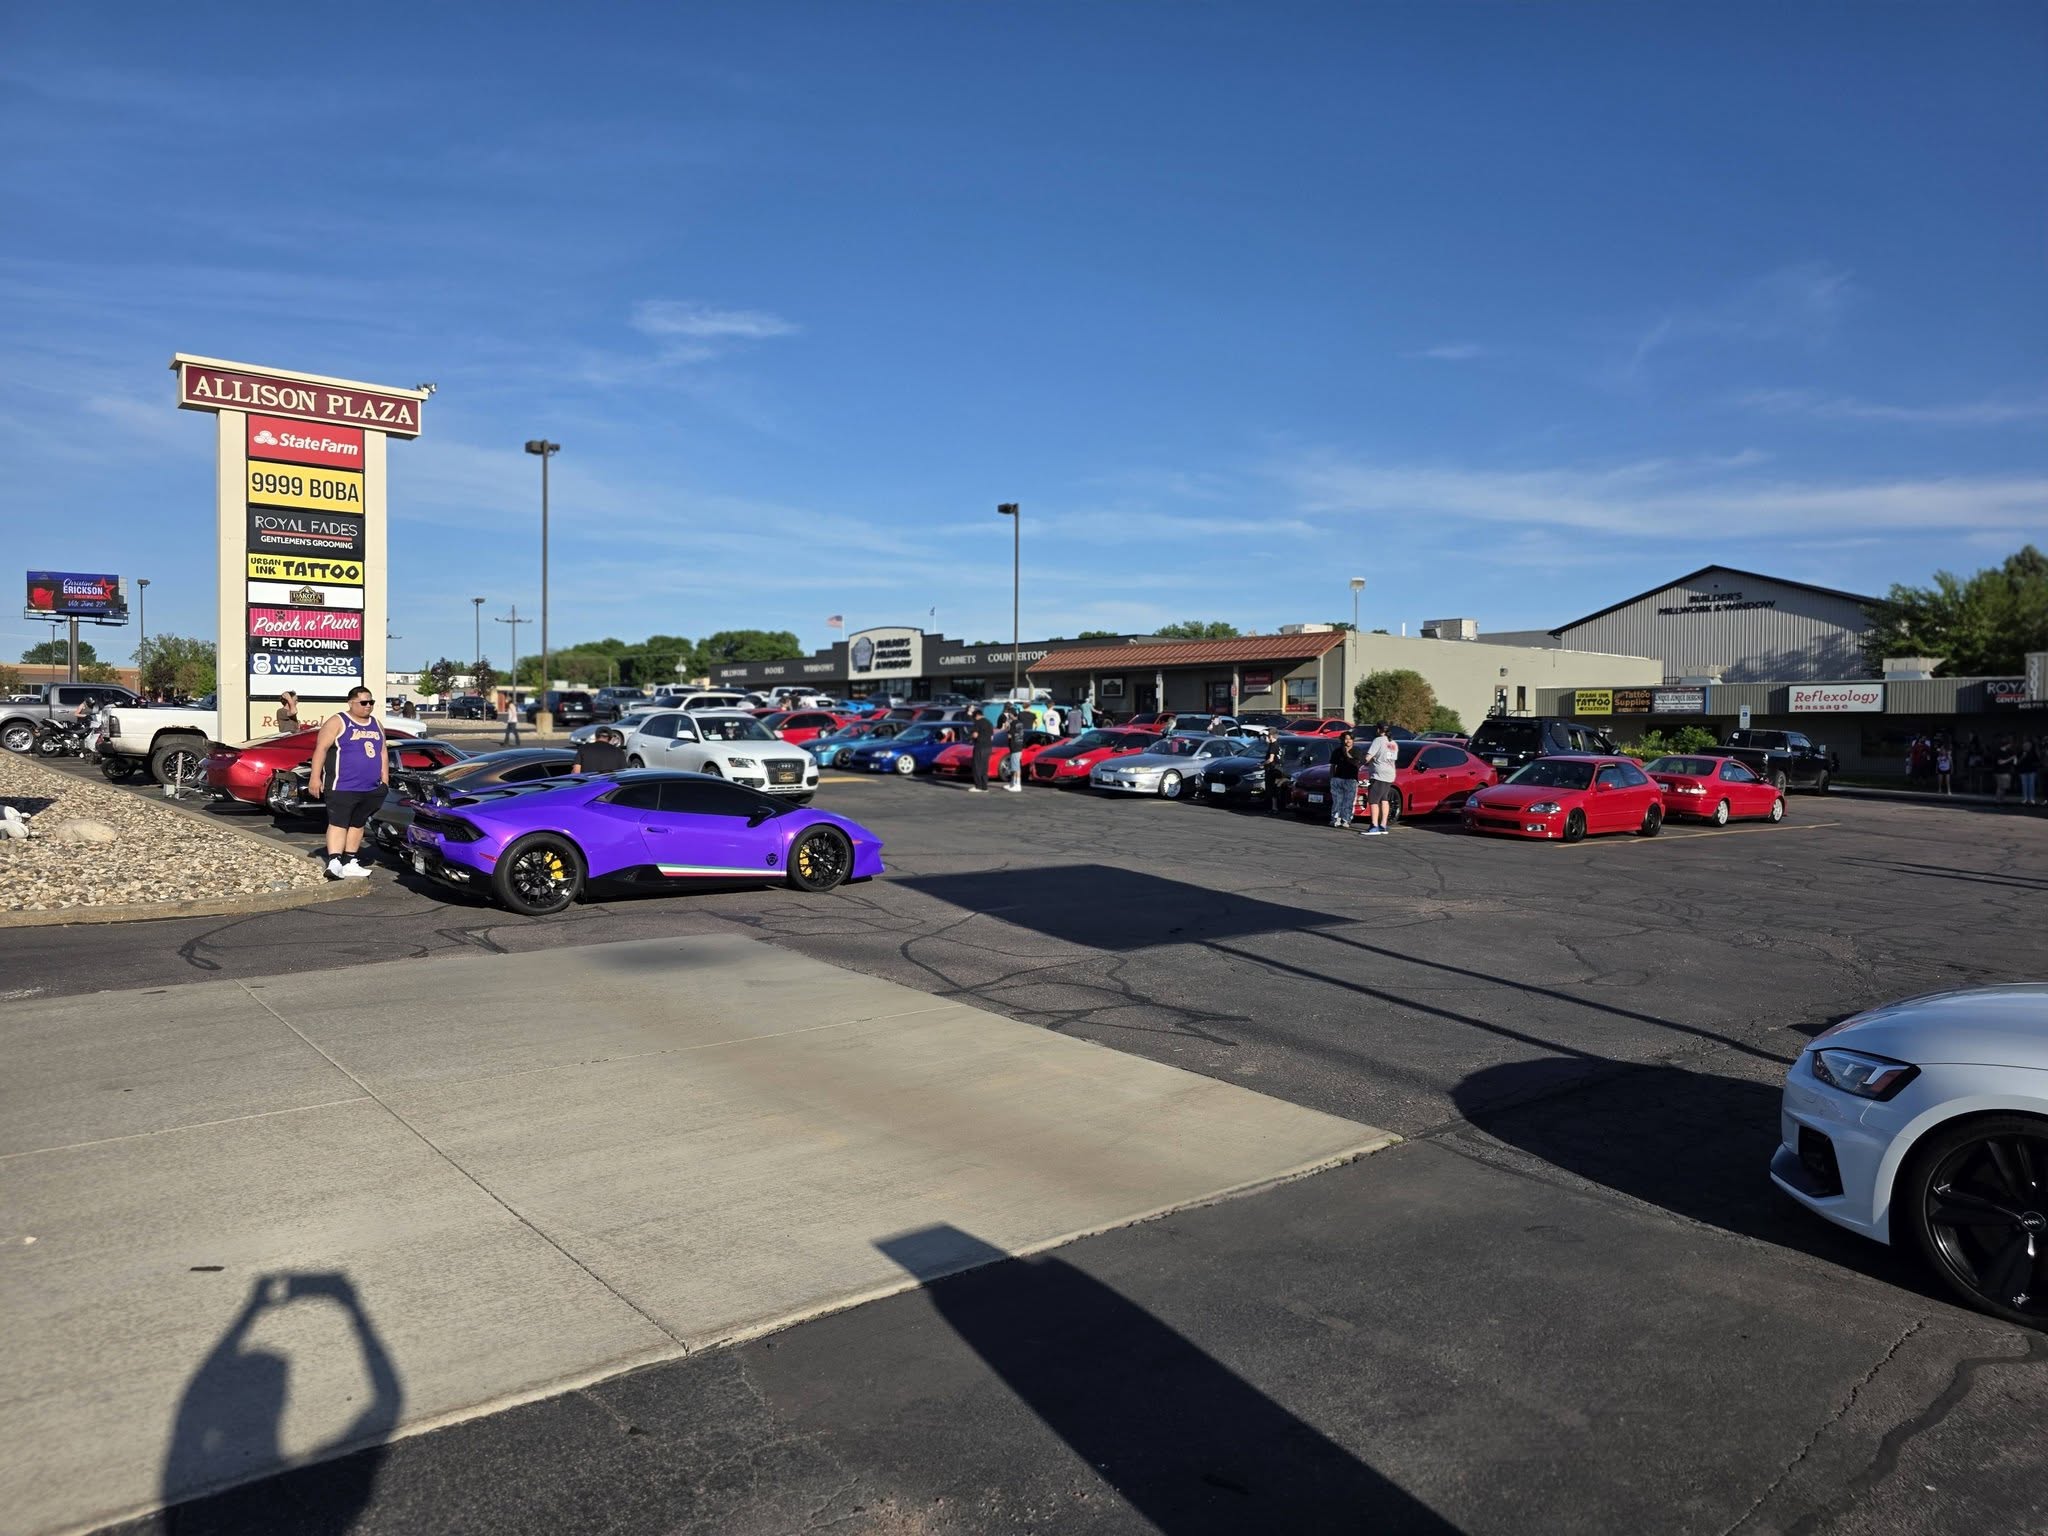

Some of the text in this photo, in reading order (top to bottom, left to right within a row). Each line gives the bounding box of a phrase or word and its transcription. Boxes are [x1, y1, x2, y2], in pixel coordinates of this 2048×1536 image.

[193, 375, 414, 425] ALLISON PLAZA
[252, 472, 360, 502] 9999 BOBA
[255, 515, 358, 537] ROYAL FADES
[260, 535, 354, 550] GENTLEMEN'S GROOMING
[250, 557, 281, 566] URBAN
[255, 565, 277, 576] INK
[283, 560, 360, 580] TATTOO
[63, 586, 103, 595] ERICKSON
[293, 592, 321, 600] DAKOTA
[1689, 592, 1743, 602] BUILDER'S
[1658, 605, 1712, 616] MILLWORK
[1723, 600, 1776, 611] WINDOW
[253, 615, 302, 633] Pooch
[262, 637, 349, 650] PET GROOMING
[277, 655, 354, 666] MINDBODY
[939, 655, 977, 665] CABINETS
[274, 664, 358, 675] WELLNESS
[1624, 690, 1651, 699] Tattoo
[1794, 689, 1879, 704] Reflexology
[1576, 699, 1611, 707] TATTOO
[1614, 699, 1651, 707] Supplies
[1794, 703, 1849, 711] Massage
[364, 740, 377, 759] 6
